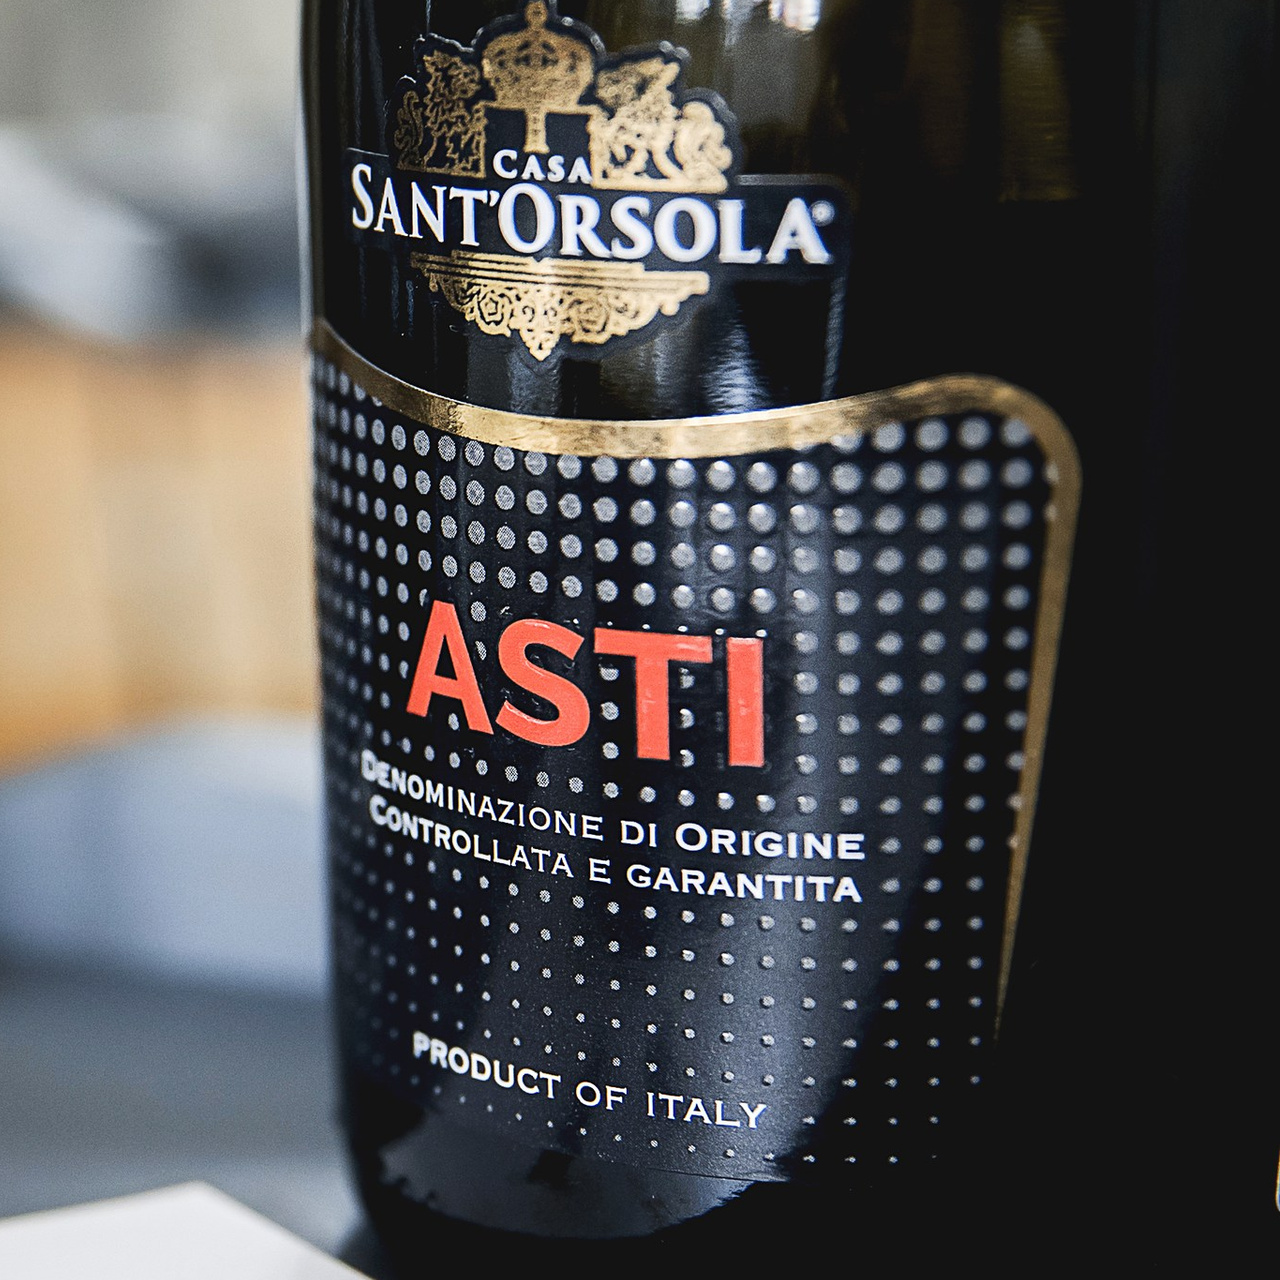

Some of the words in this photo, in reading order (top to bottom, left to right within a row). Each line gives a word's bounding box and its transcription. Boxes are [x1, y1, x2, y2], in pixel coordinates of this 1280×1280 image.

[492, 149, 591, 184] CASA
[406, 599, 766, 768] ASTI
[360, 749, 604, 842] DENOMINAZIONE
[620, 820, 658, 849] DI
[675, 822, 866, 861] ORIGINE
[369, 796, 575, 879] CONTROLLATA
[589, 858, 612, 885] E
[626, 864, 864, 904] GARANTITA
[413, 1031, 562, 1099] PRODUCT
[576, 1080, 628, 1112] OF
[646, 1091, 768, 1130] ITALY
